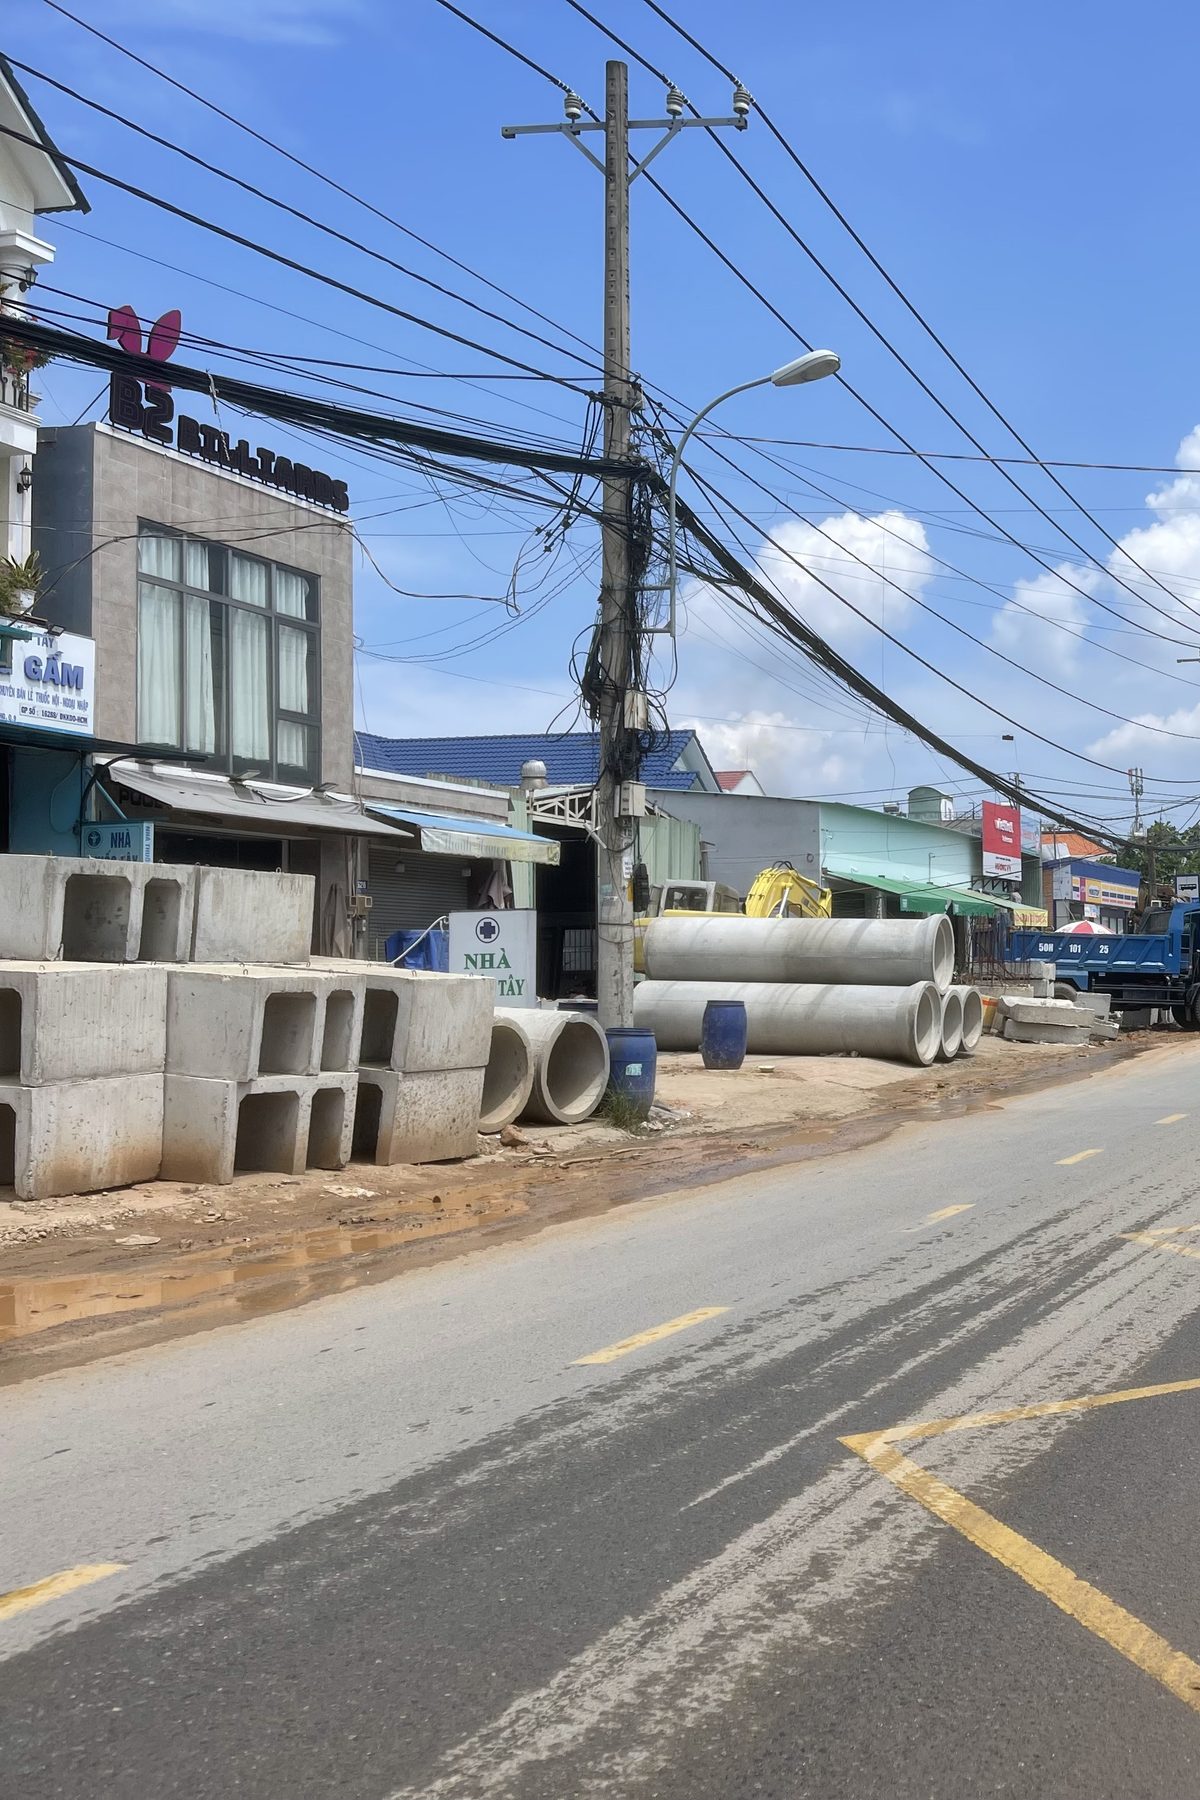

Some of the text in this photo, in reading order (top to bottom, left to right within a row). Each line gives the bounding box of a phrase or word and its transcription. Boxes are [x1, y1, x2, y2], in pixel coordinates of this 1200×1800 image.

[177, 415, 349, 512] BILLIARDS
[24, 651, 84, 690] GẤM
[111, 829, 131, 848] NHÀ
[464, 947, 511, 970] NHÀ
[1069, 944, 1081, 953] 101
[1099, 945, 1109, 954] 25
[498, 974, 525, 996] TÂY
